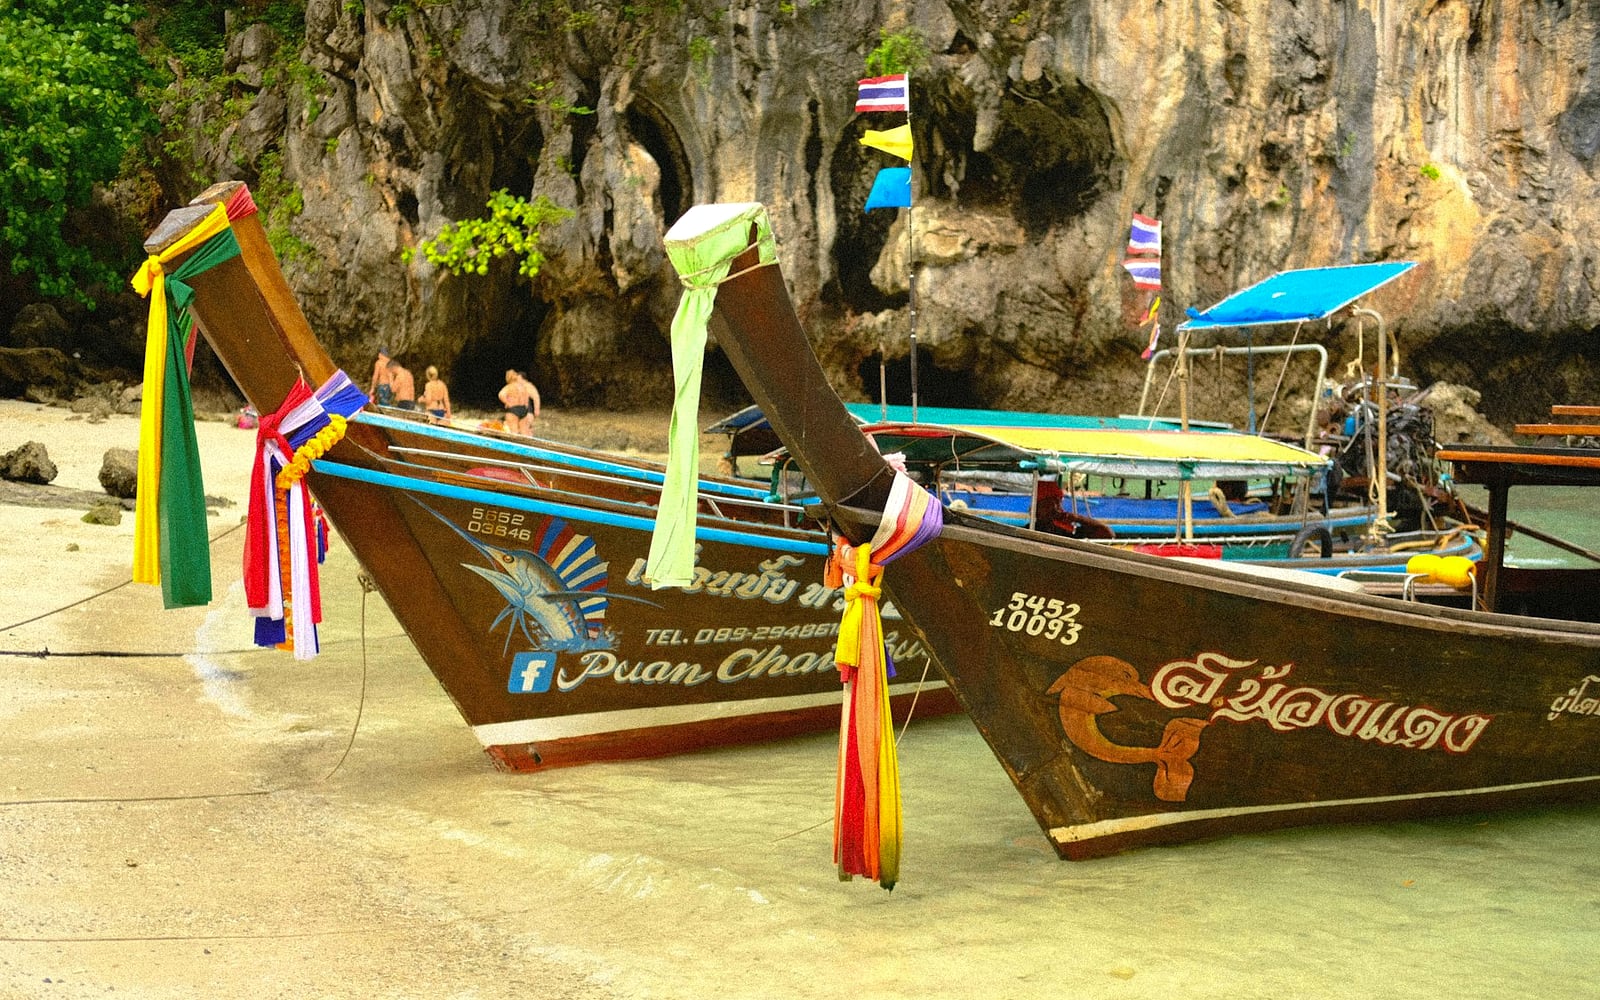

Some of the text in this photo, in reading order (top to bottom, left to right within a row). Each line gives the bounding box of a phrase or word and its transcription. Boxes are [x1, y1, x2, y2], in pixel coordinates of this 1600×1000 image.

[467, 521, 532, 541] 03846
[1007, 591, 1081, 622] 5452
[645, 623, 840, 646] TEL. 089-294861
[989, 607, 1084, 646] 10093
[556, 651, 713, 692] Puan
